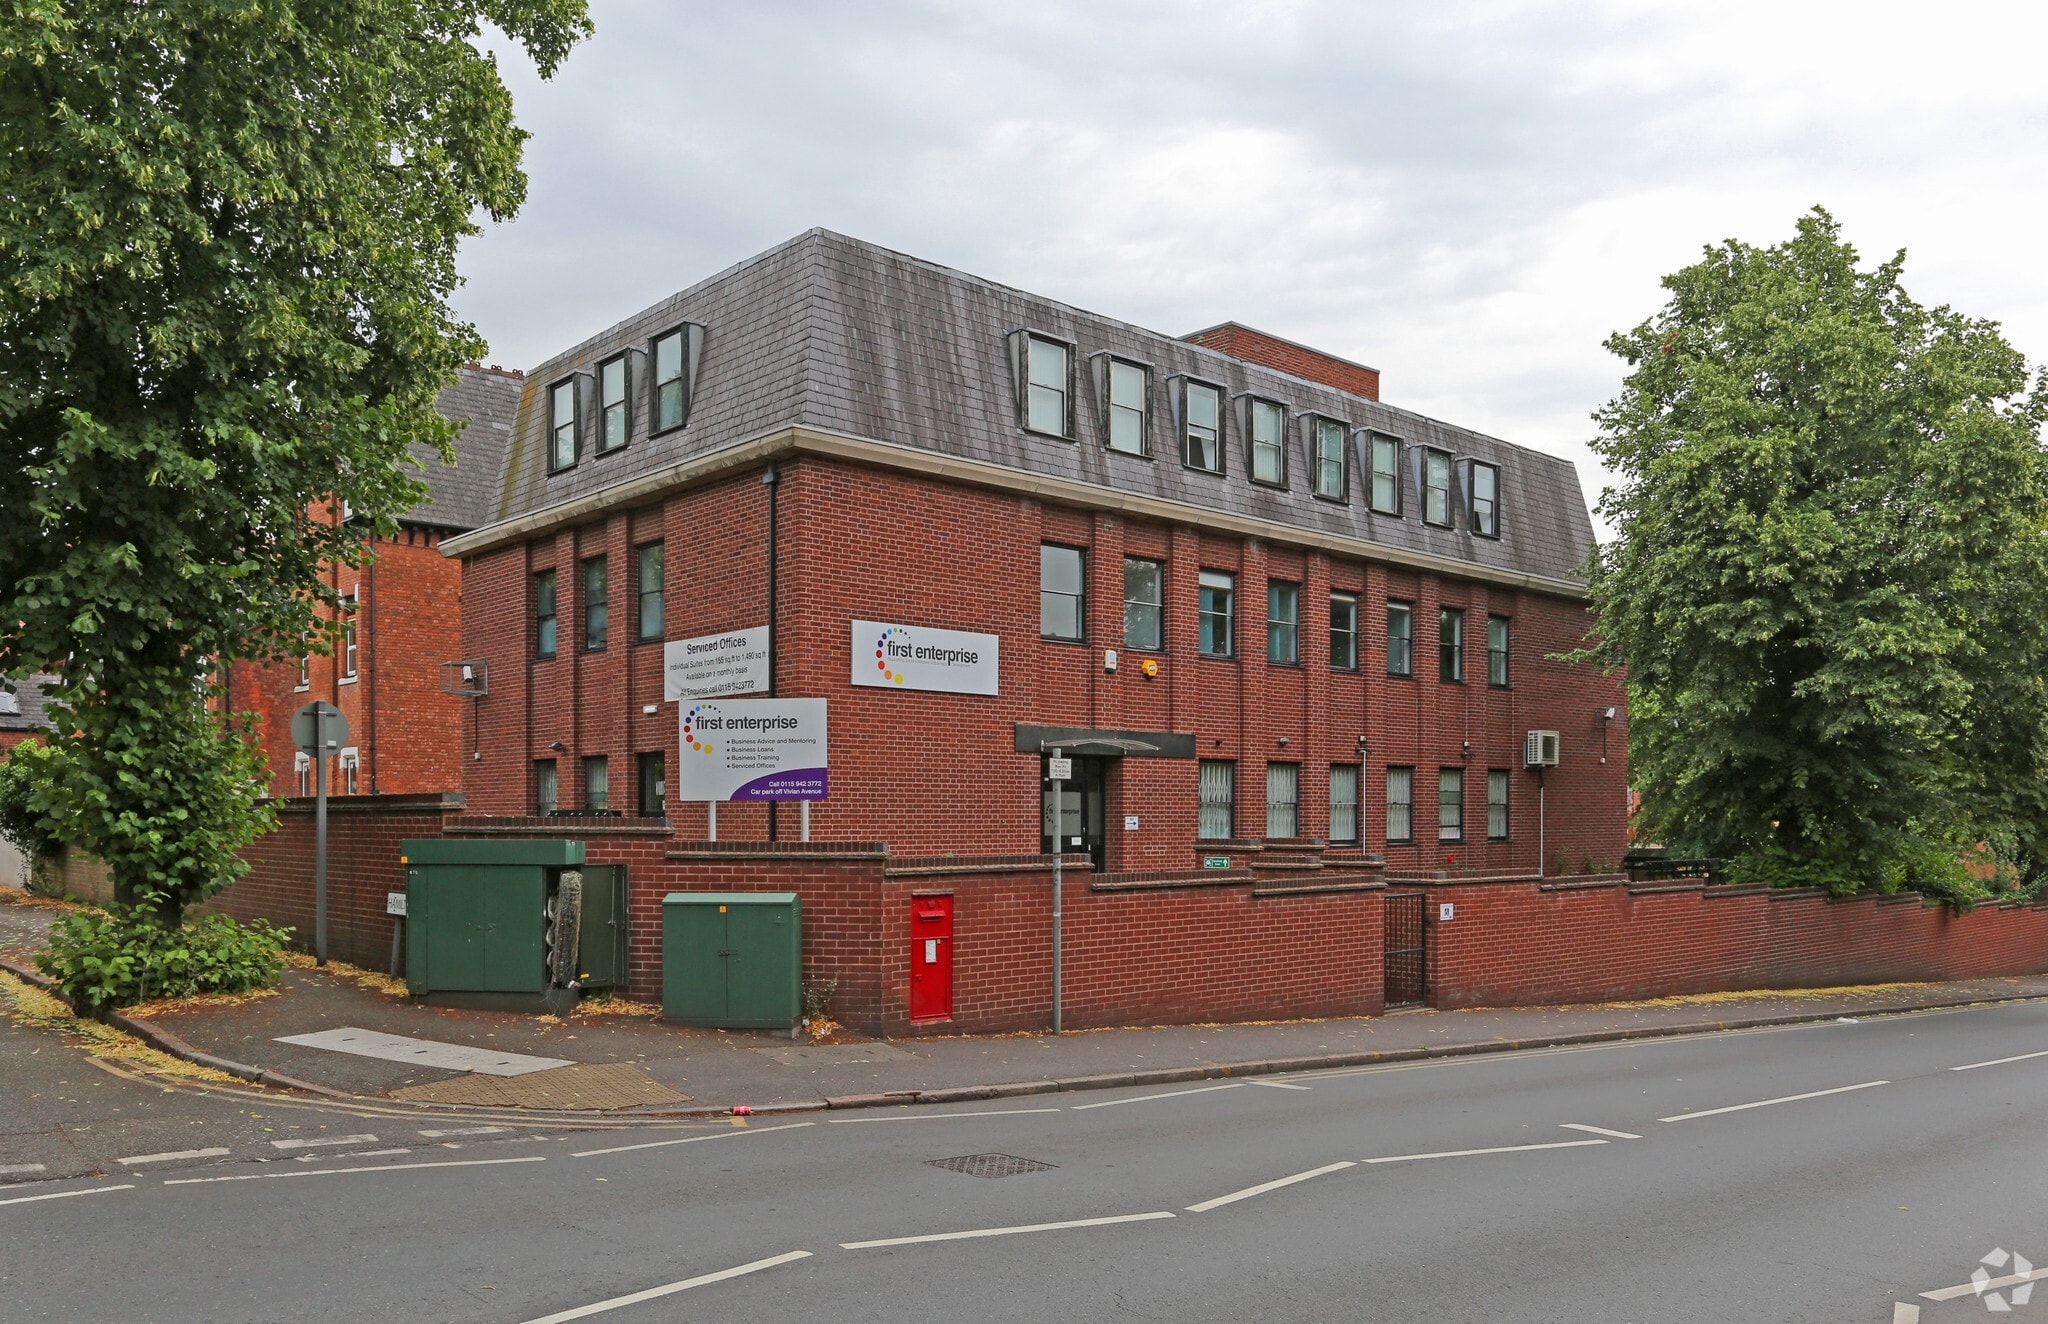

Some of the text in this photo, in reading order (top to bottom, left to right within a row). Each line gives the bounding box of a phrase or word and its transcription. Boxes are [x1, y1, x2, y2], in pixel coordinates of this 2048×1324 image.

[687, 637, 746, 654] Serviced Offices
[887, 640, 978, 666] first enterprise
[670, 662, 689, 670] Individual
[690, 659, 703, 668] Suites
[704, 658, 714, 666] from
[686, 672, 705, 680] Available
[717, 668, 734, 676] monthly
[687, 687, 708, 696] Enquiries
[709, 685, 717, 693] call
[696, 715, 798, 733] first enterprise
